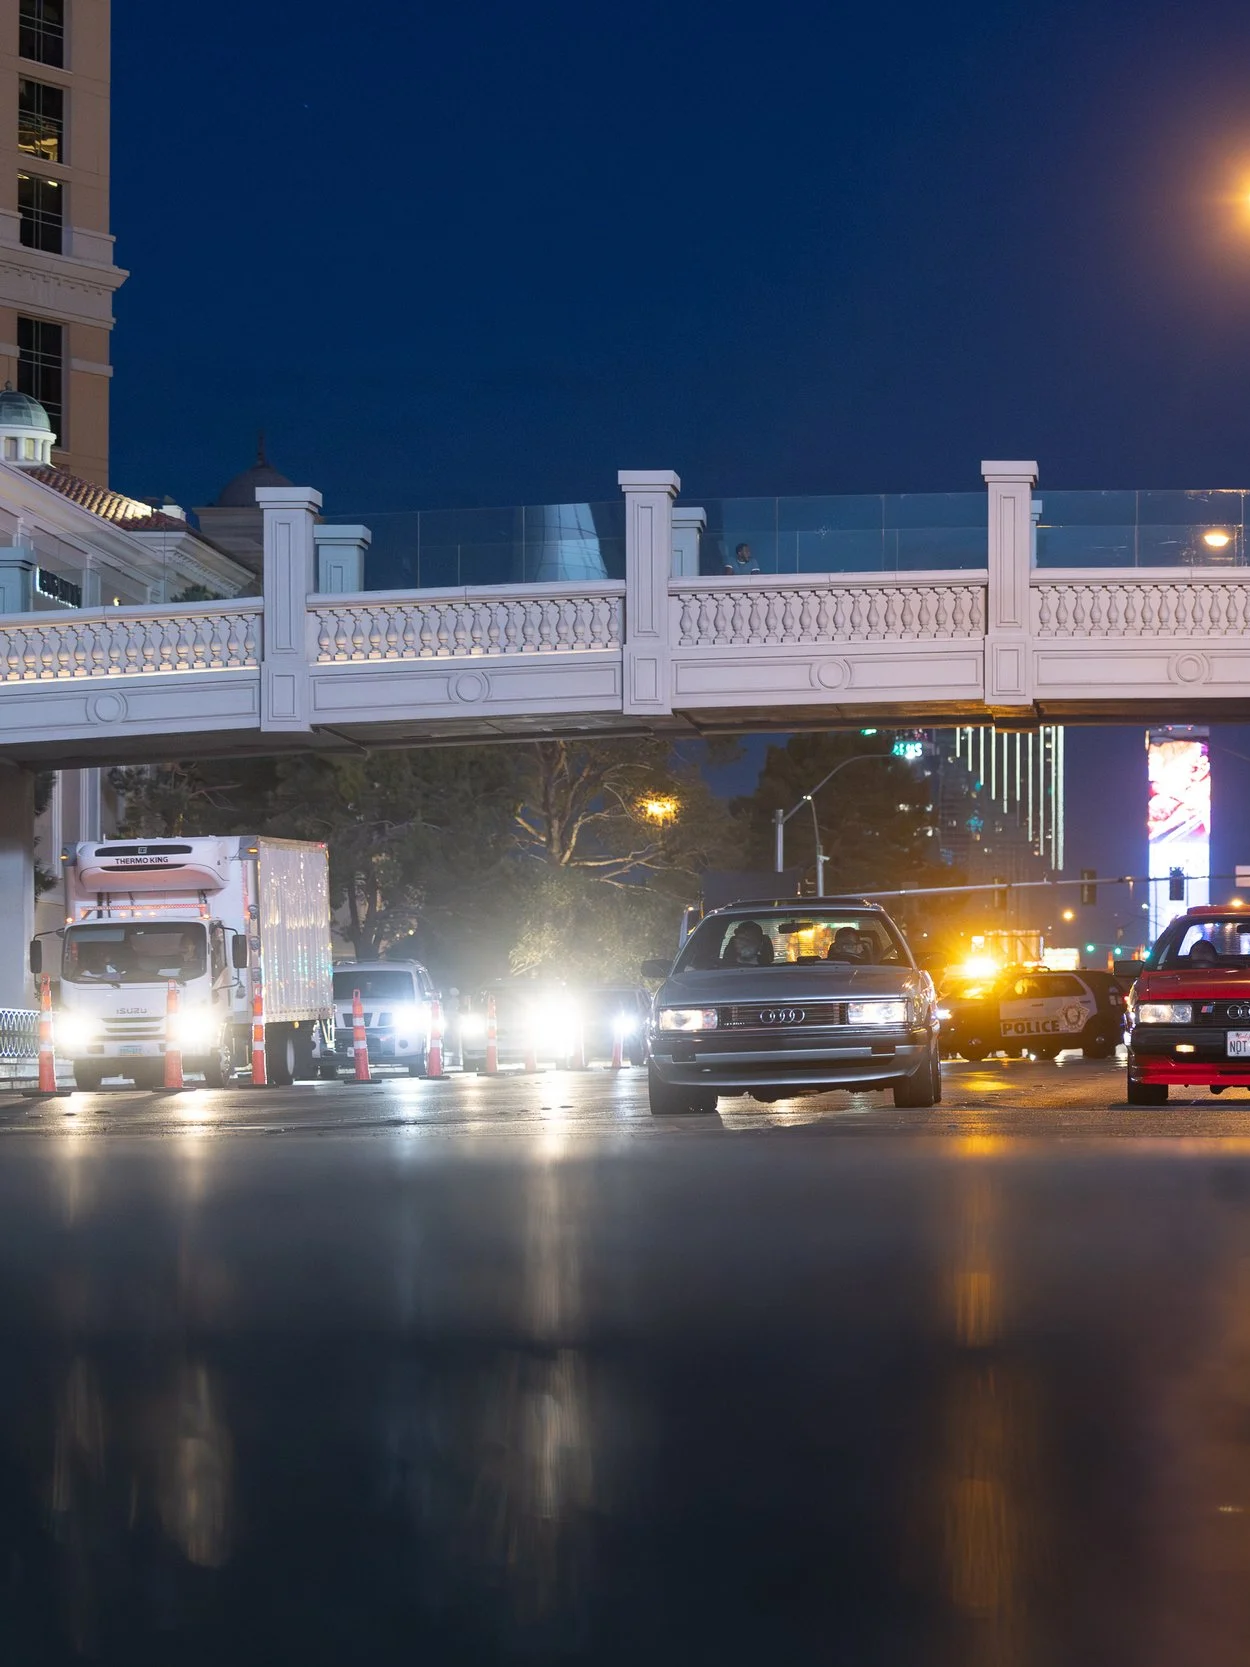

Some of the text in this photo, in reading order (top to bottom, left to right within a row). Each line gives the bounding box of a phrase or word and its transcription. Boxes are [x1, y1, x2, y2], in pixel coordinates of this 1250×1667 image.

[115, 856, 169, 865] THERMO KING
[116, 1007, 147, 1015] ISUZU
[1002, 1020, 1060, 1035] POLICE
[1229, 1040, 1247, 1053] NOT
